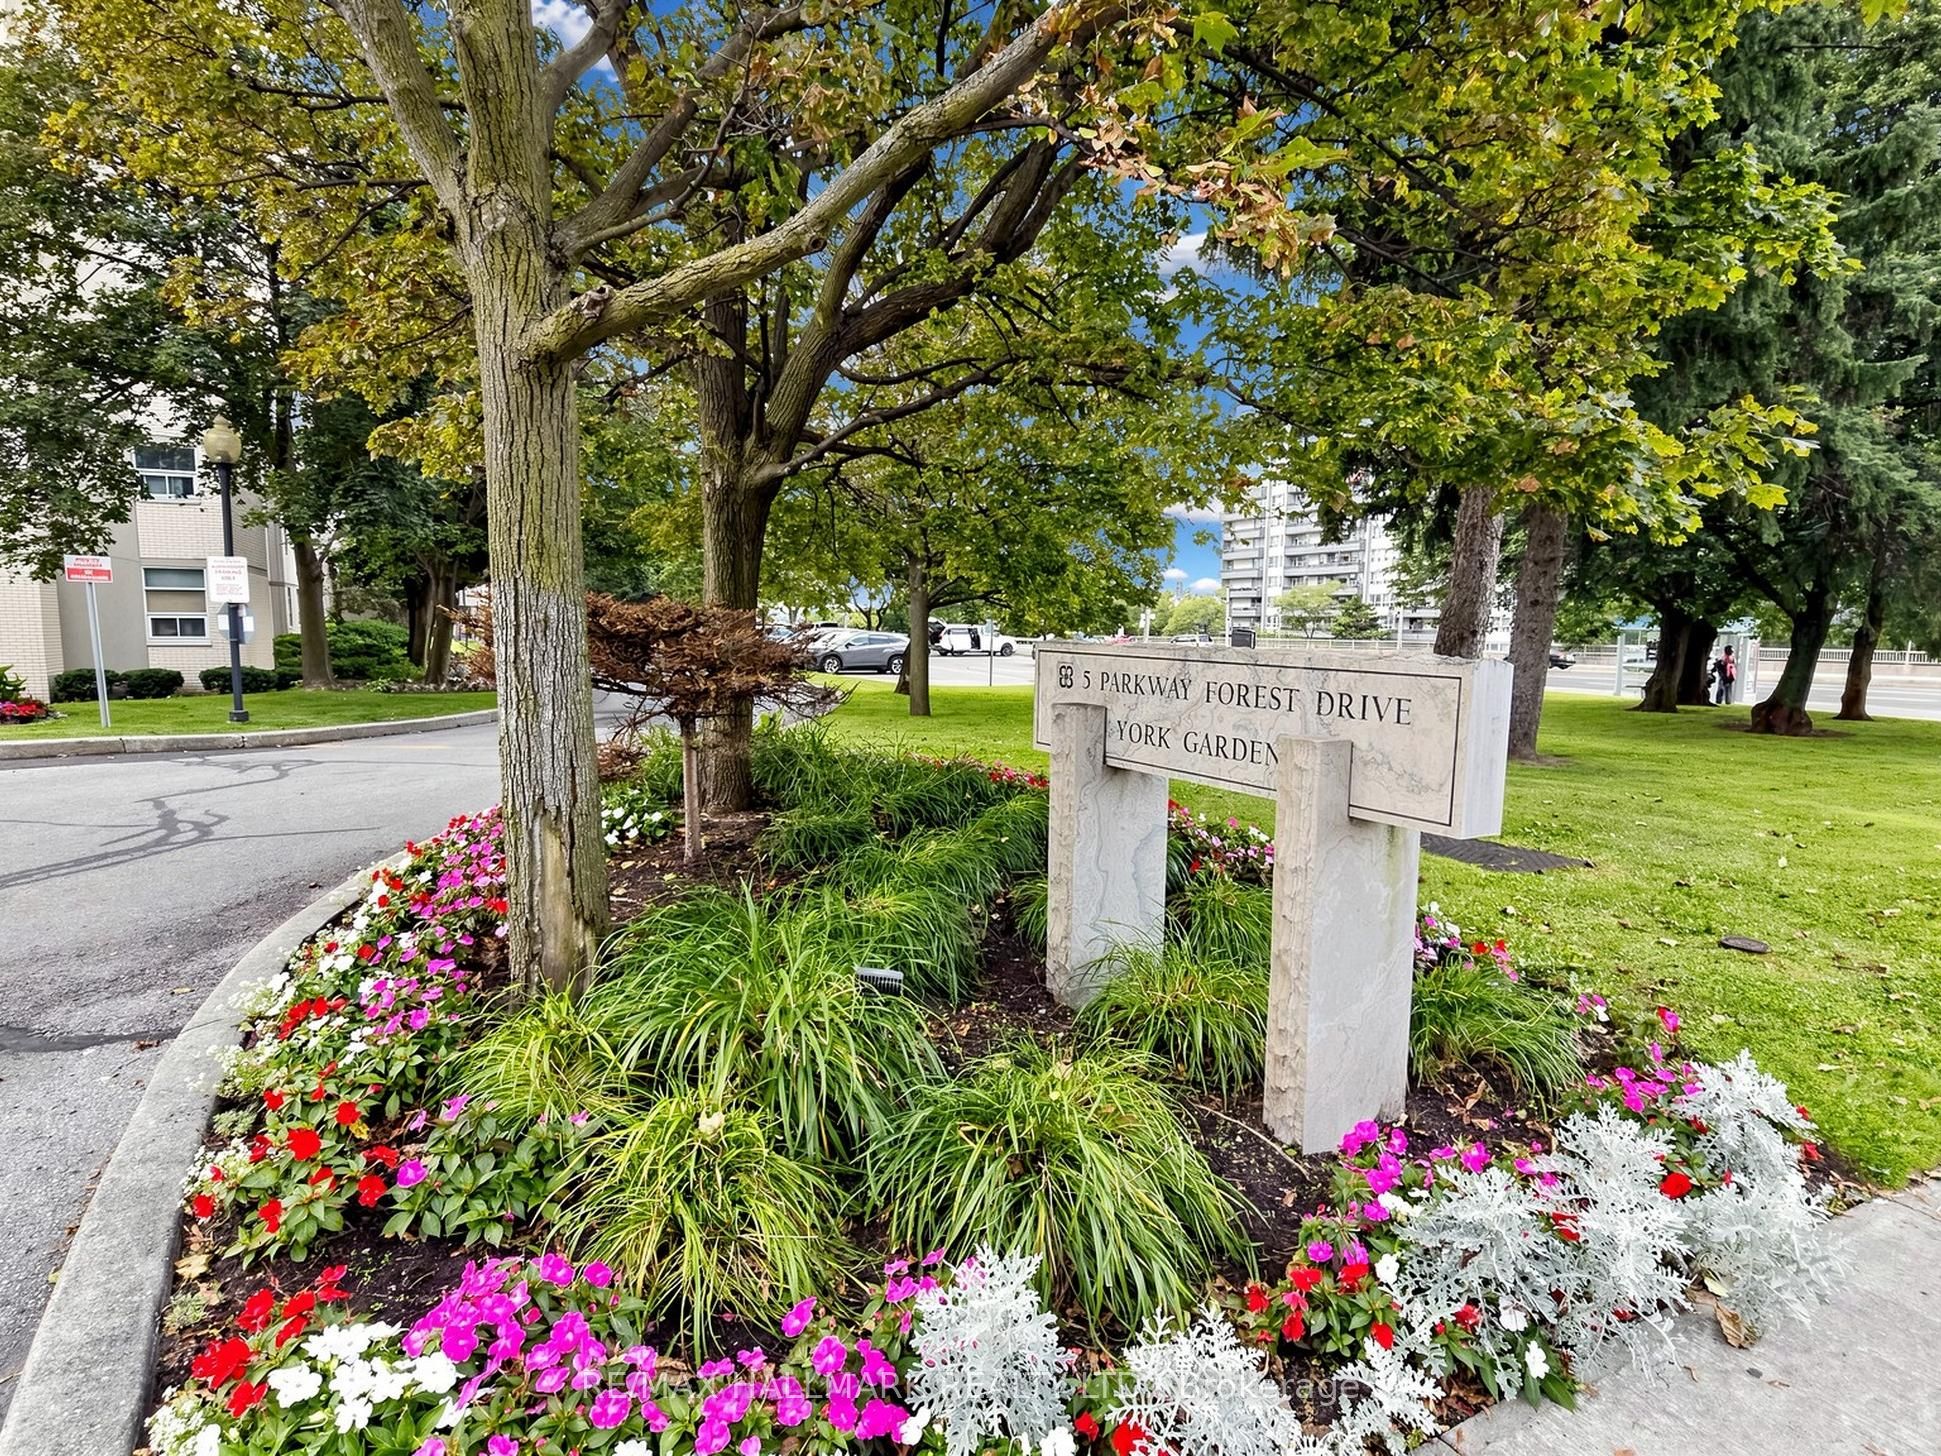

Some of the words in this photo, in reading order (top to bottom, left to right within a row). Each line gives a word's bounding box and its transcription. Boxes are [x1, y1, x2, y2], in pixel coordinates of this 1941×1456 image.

[1082, 671, 1091, 689] 5
[1100, 672, 1192, 701] PARKWAY
[1206, 681, 1300, 712] FOREST
[1316, 690, 1412, 725] DRIVE
[1117, 720, 1171, 749] YORK
